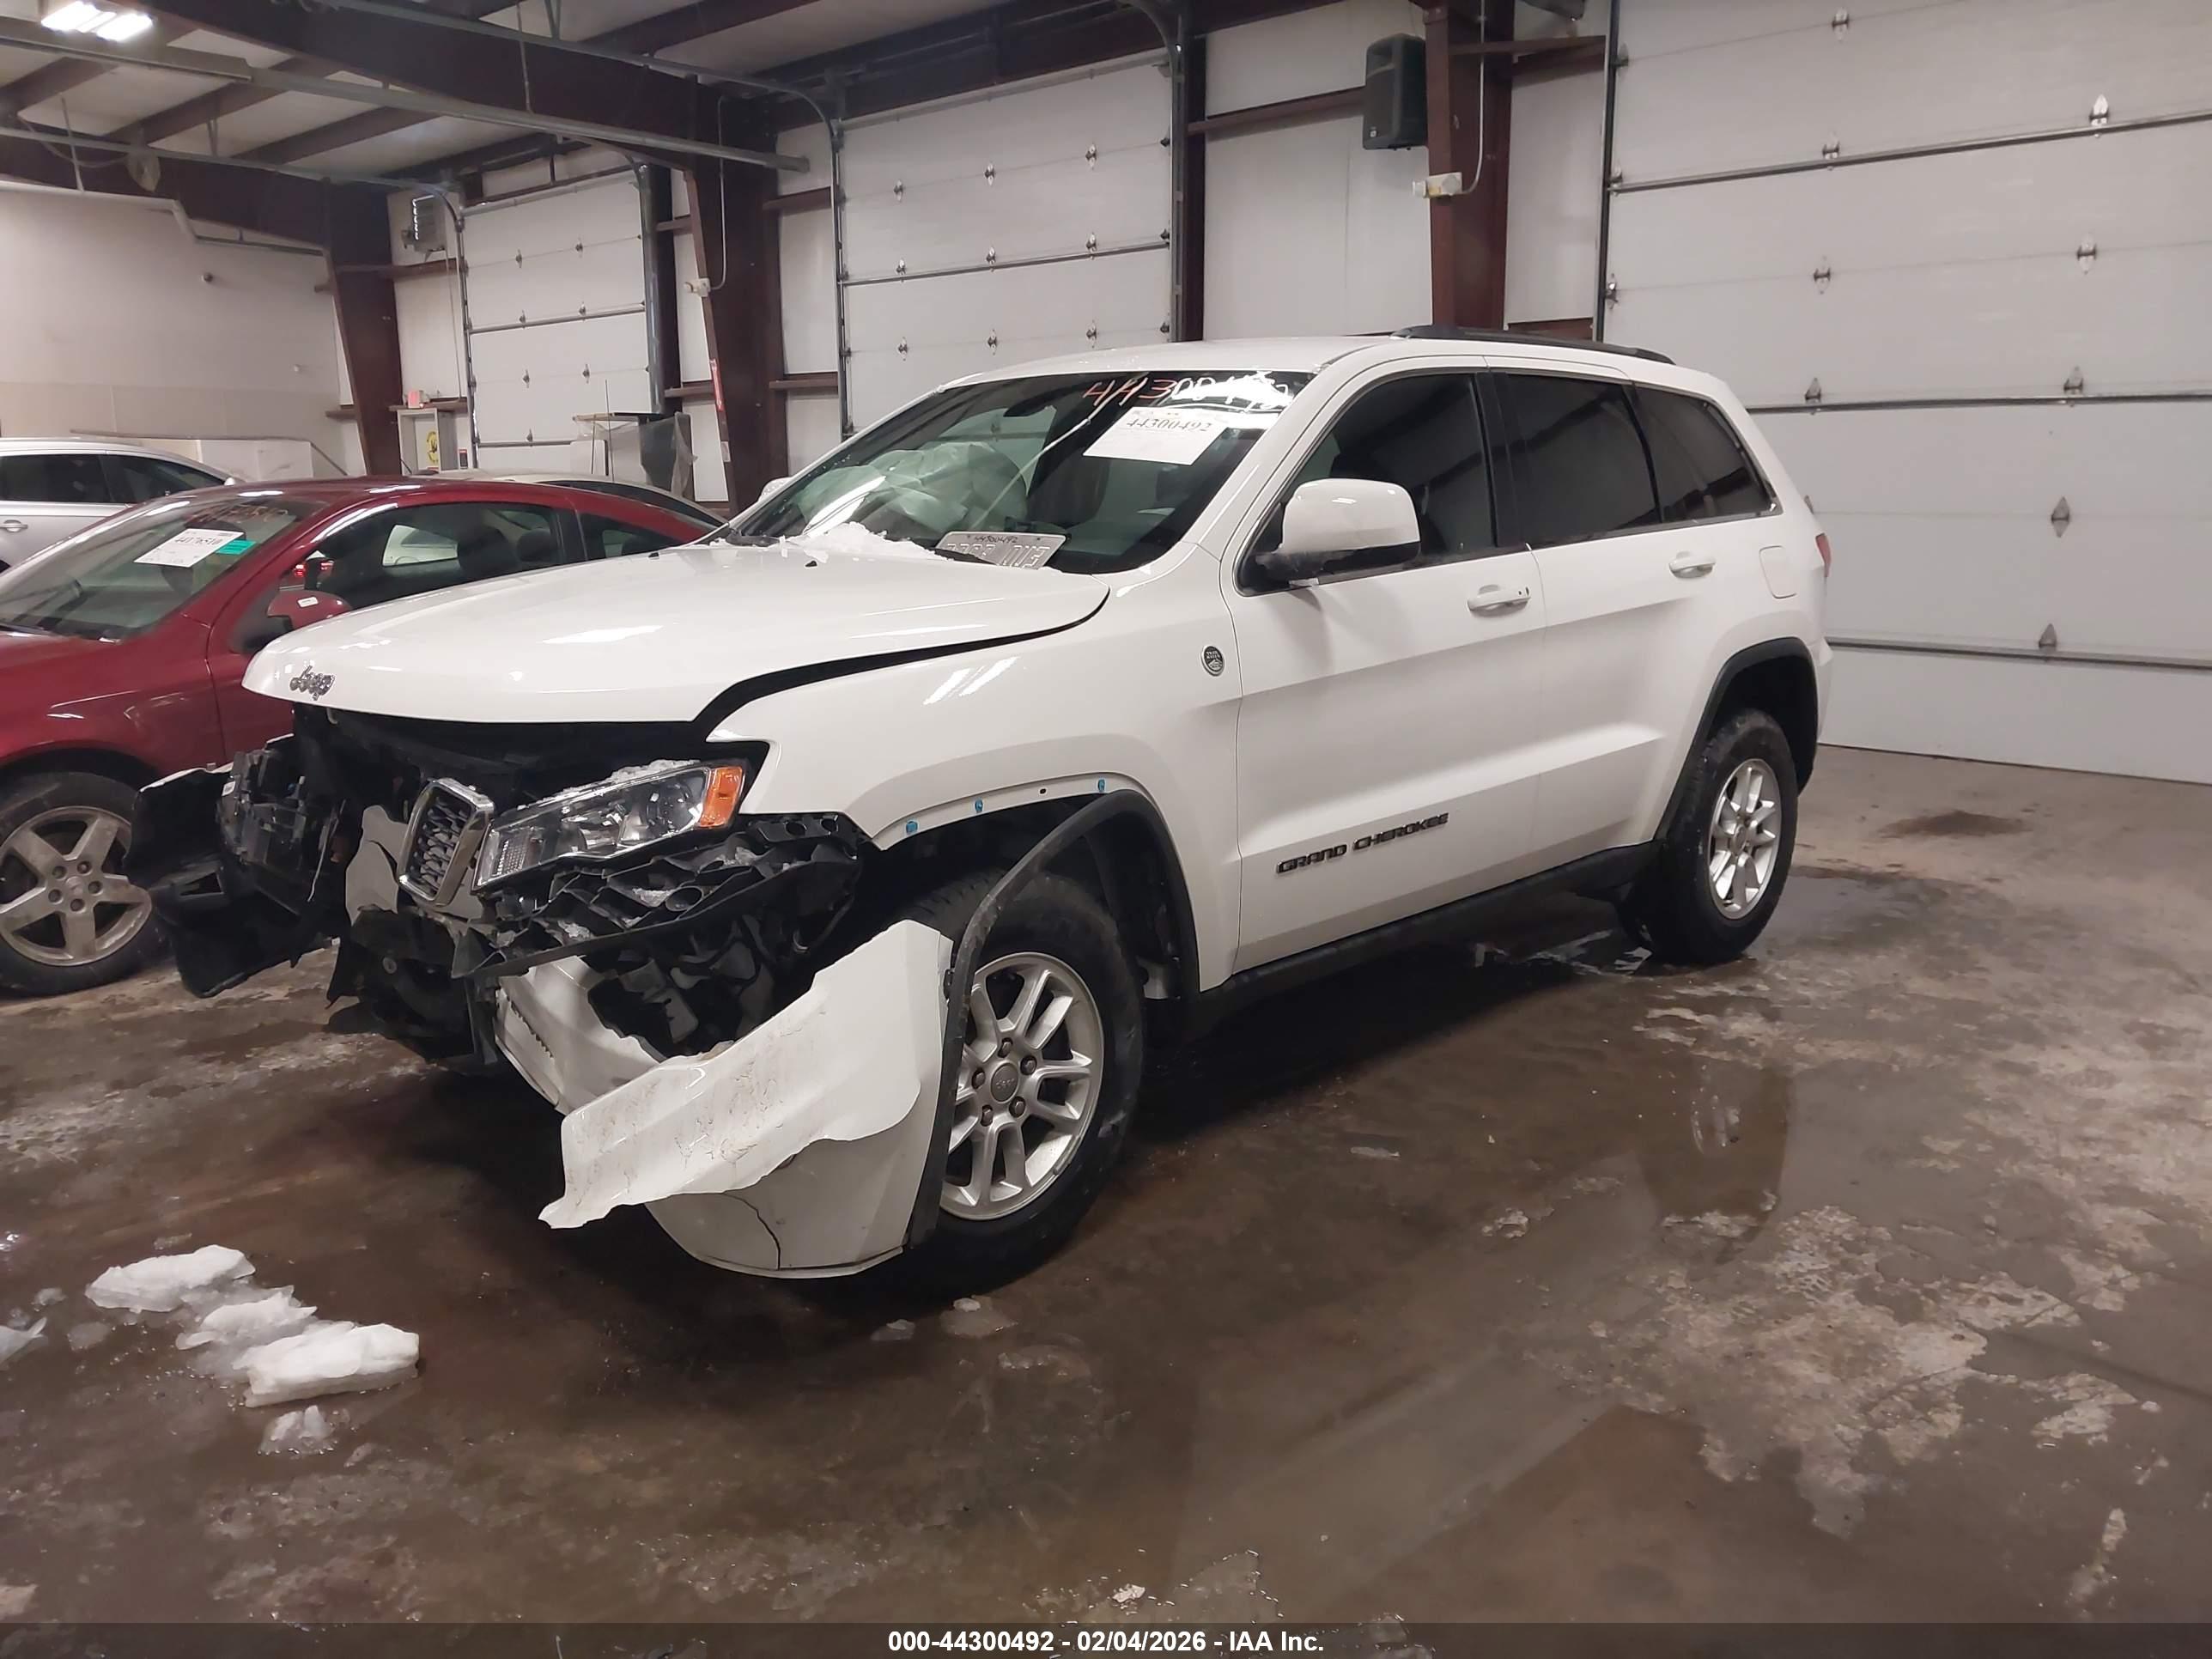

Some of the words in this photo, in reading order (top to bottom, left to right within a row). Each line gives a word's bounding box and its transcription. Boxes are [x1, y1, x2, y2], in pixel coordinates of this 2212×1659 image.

[1126, 418, 1213, 432] 44300492
[1276, 843, 1347, 874] GRAND
[1352, 811, 1449, 852] CHEROKEE
